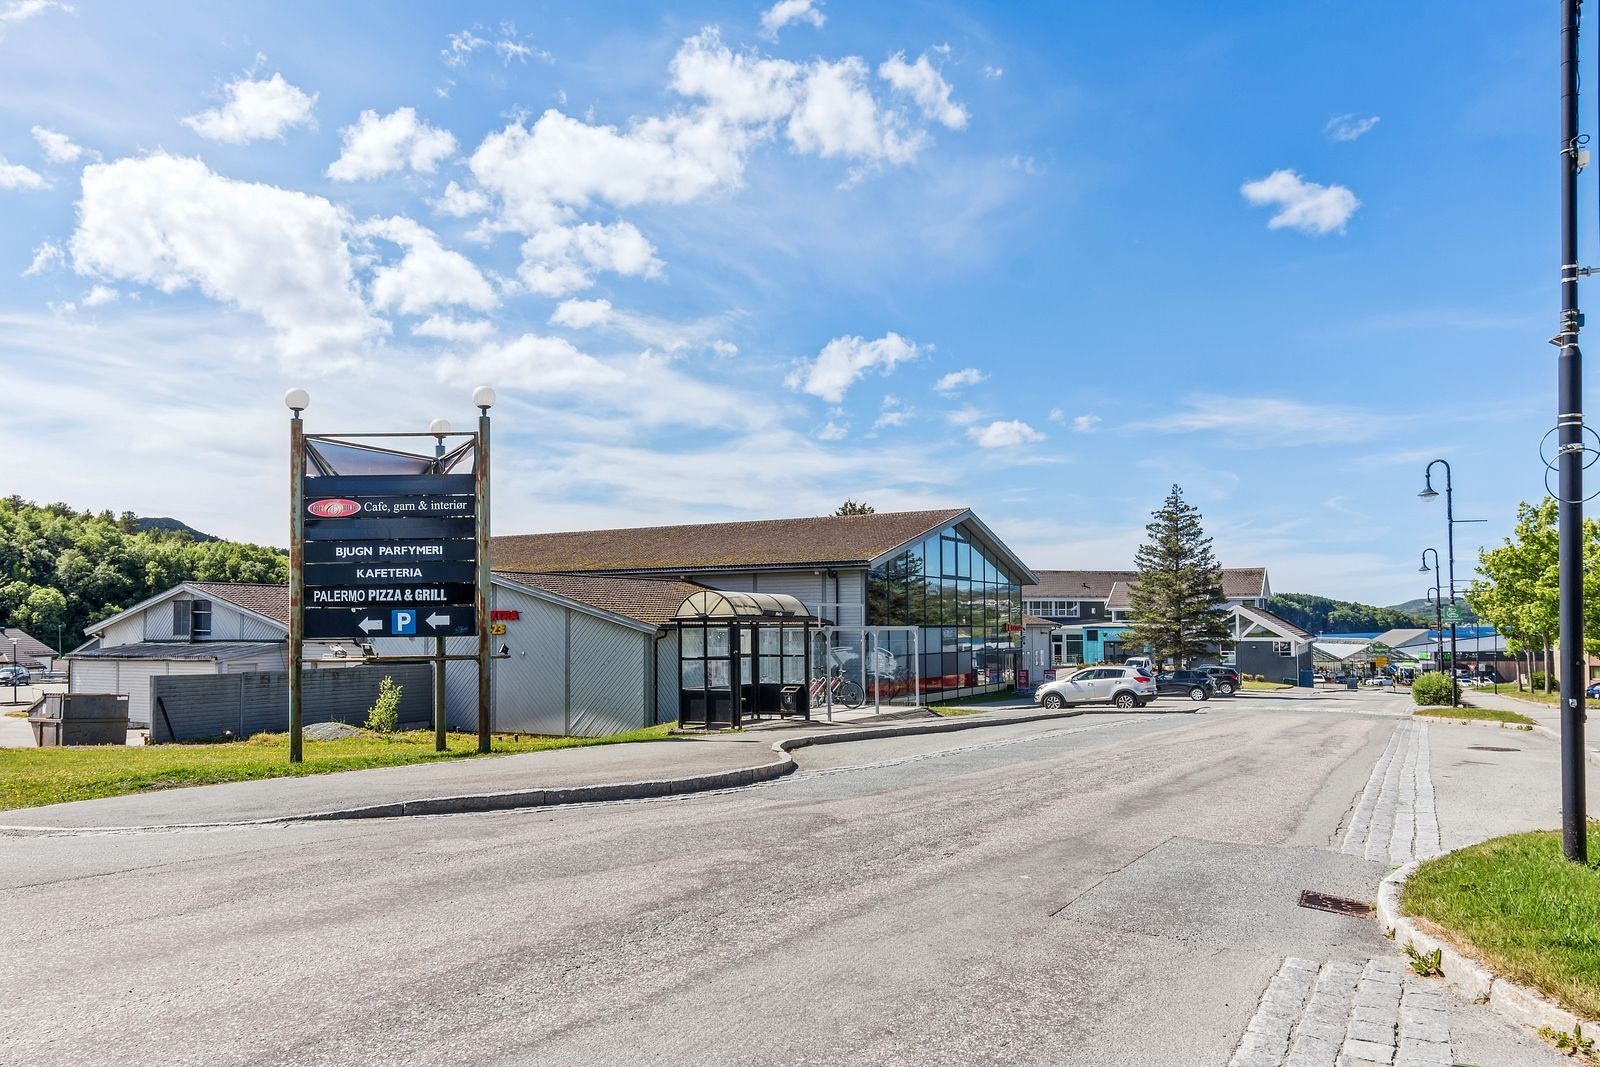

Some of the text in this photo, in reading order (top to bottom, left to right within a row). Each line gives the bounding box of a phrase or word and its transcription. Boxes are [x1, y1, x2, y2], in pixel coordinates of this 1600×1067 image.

[363, 501, 391, 512] Cafe,
[393, 502, 415, 513] garn
[418, 500, 428, 510] &
[431, 500, 467, 510] interiør
[335, 545, 443, 558] BJUGN PARFYMERI
[356, 567, 423, 578] KAFETERIA
[313, 588, 447, 602] PALERMO PIZZA & GRILL
[397, 612, 411, 632] P
